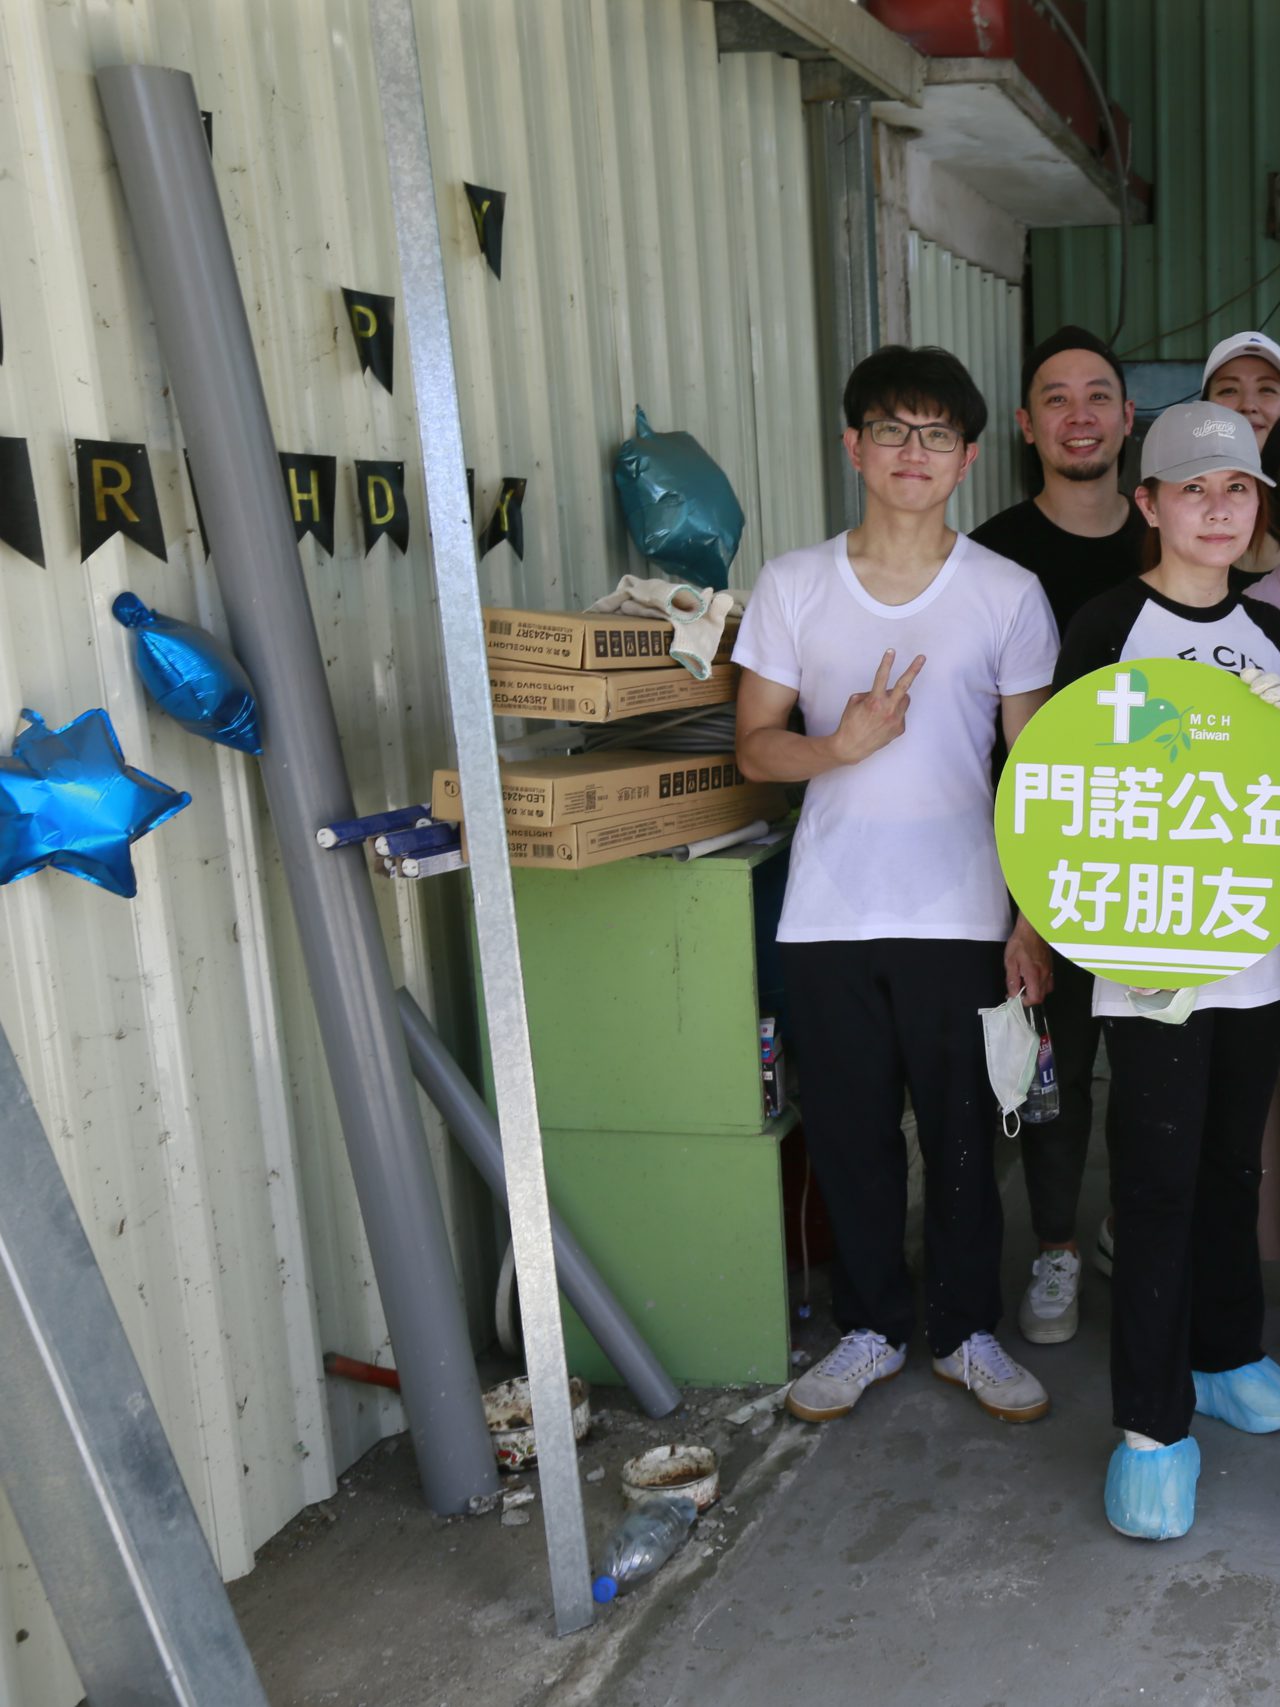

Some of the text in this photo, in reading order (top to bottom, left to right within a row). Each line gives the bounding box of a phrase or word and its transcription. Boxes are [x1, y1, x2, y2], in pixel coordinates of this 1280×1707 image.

[92, 458, 140, 523] R
[516, 628, 573, 643] LED-4243R7
[494, 693, 548, 705] ED-4243R7
[1189, 727, 1230, 741] Taiwan
[502, 791, 545, 804] LED-4243
[1048, 858, 1273, 941] 好朋友
